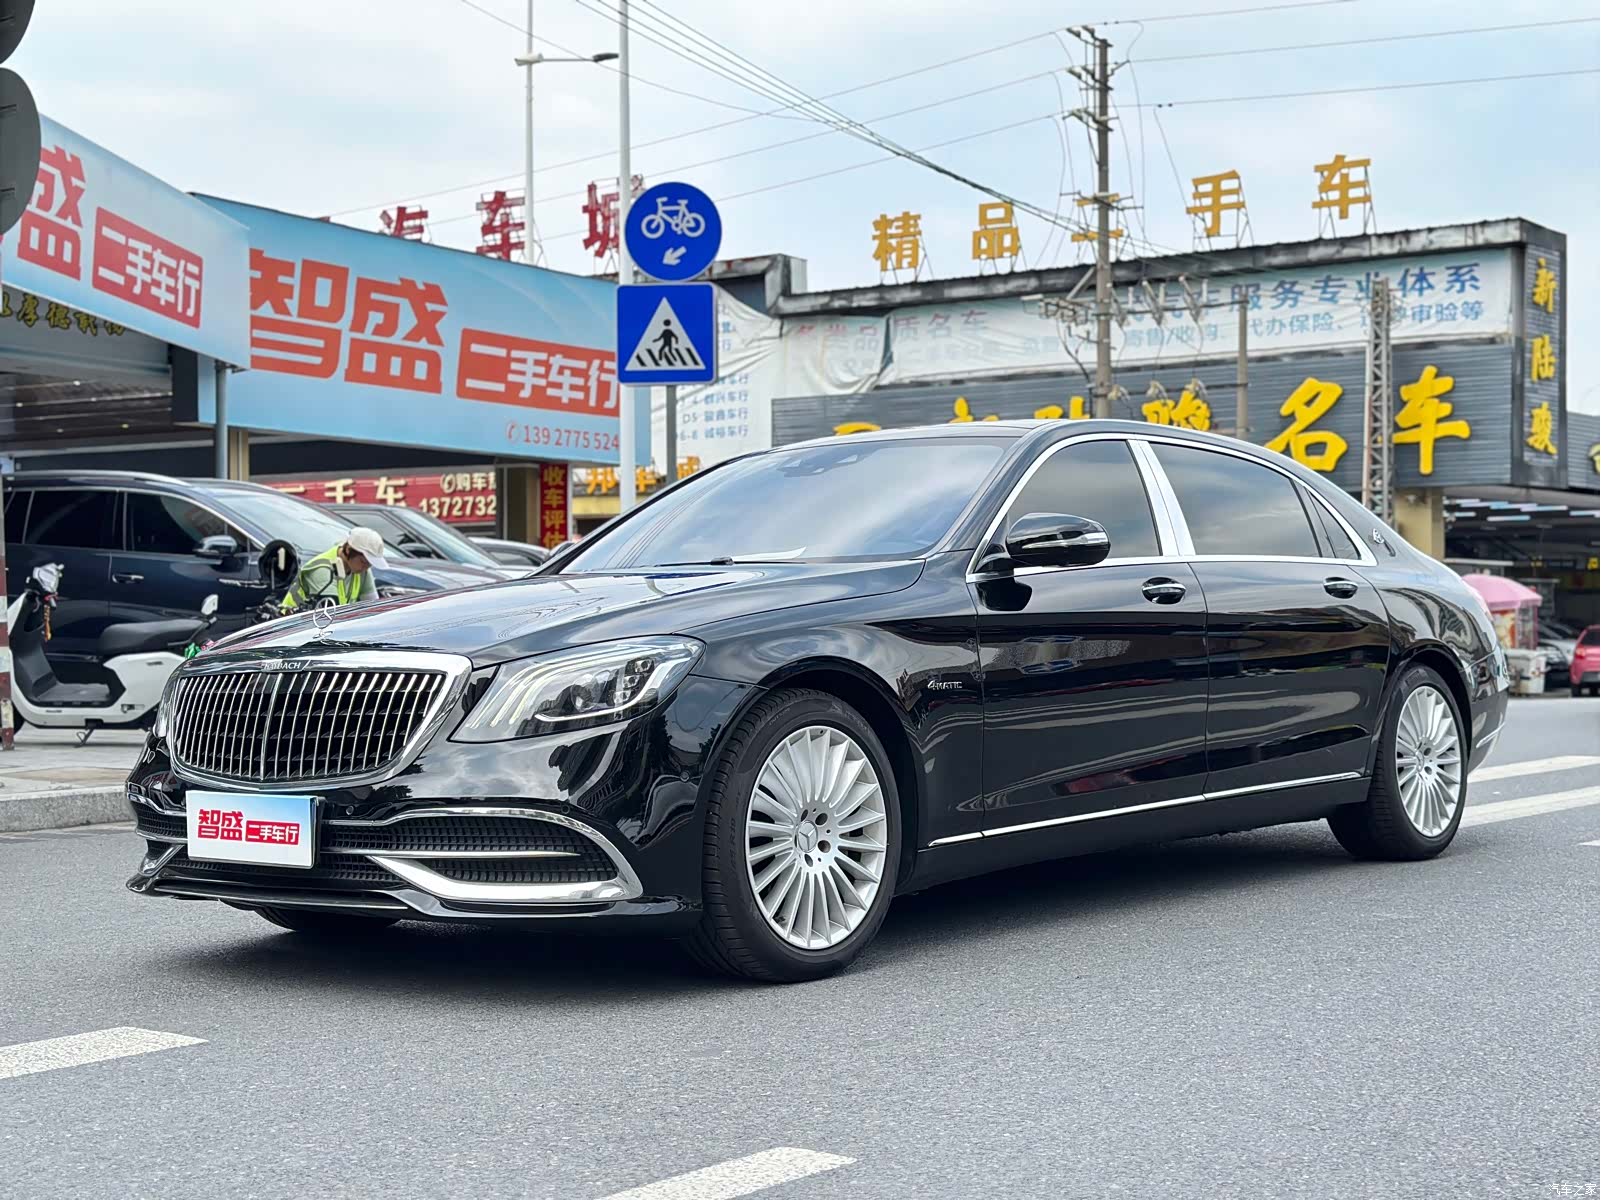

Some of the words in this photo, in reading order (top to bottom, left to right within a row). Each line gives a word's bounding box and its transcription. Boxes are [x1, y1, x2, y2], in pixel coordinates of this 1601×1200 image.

[872, 154, 1373, 272] 精品二手车
[249, 248, 448, 394] 智盛
[465, 342, 619, 410] 二手车行
[197, 808, 244, 842] 智盛
[247, 822, 300, 844] 二手车行
